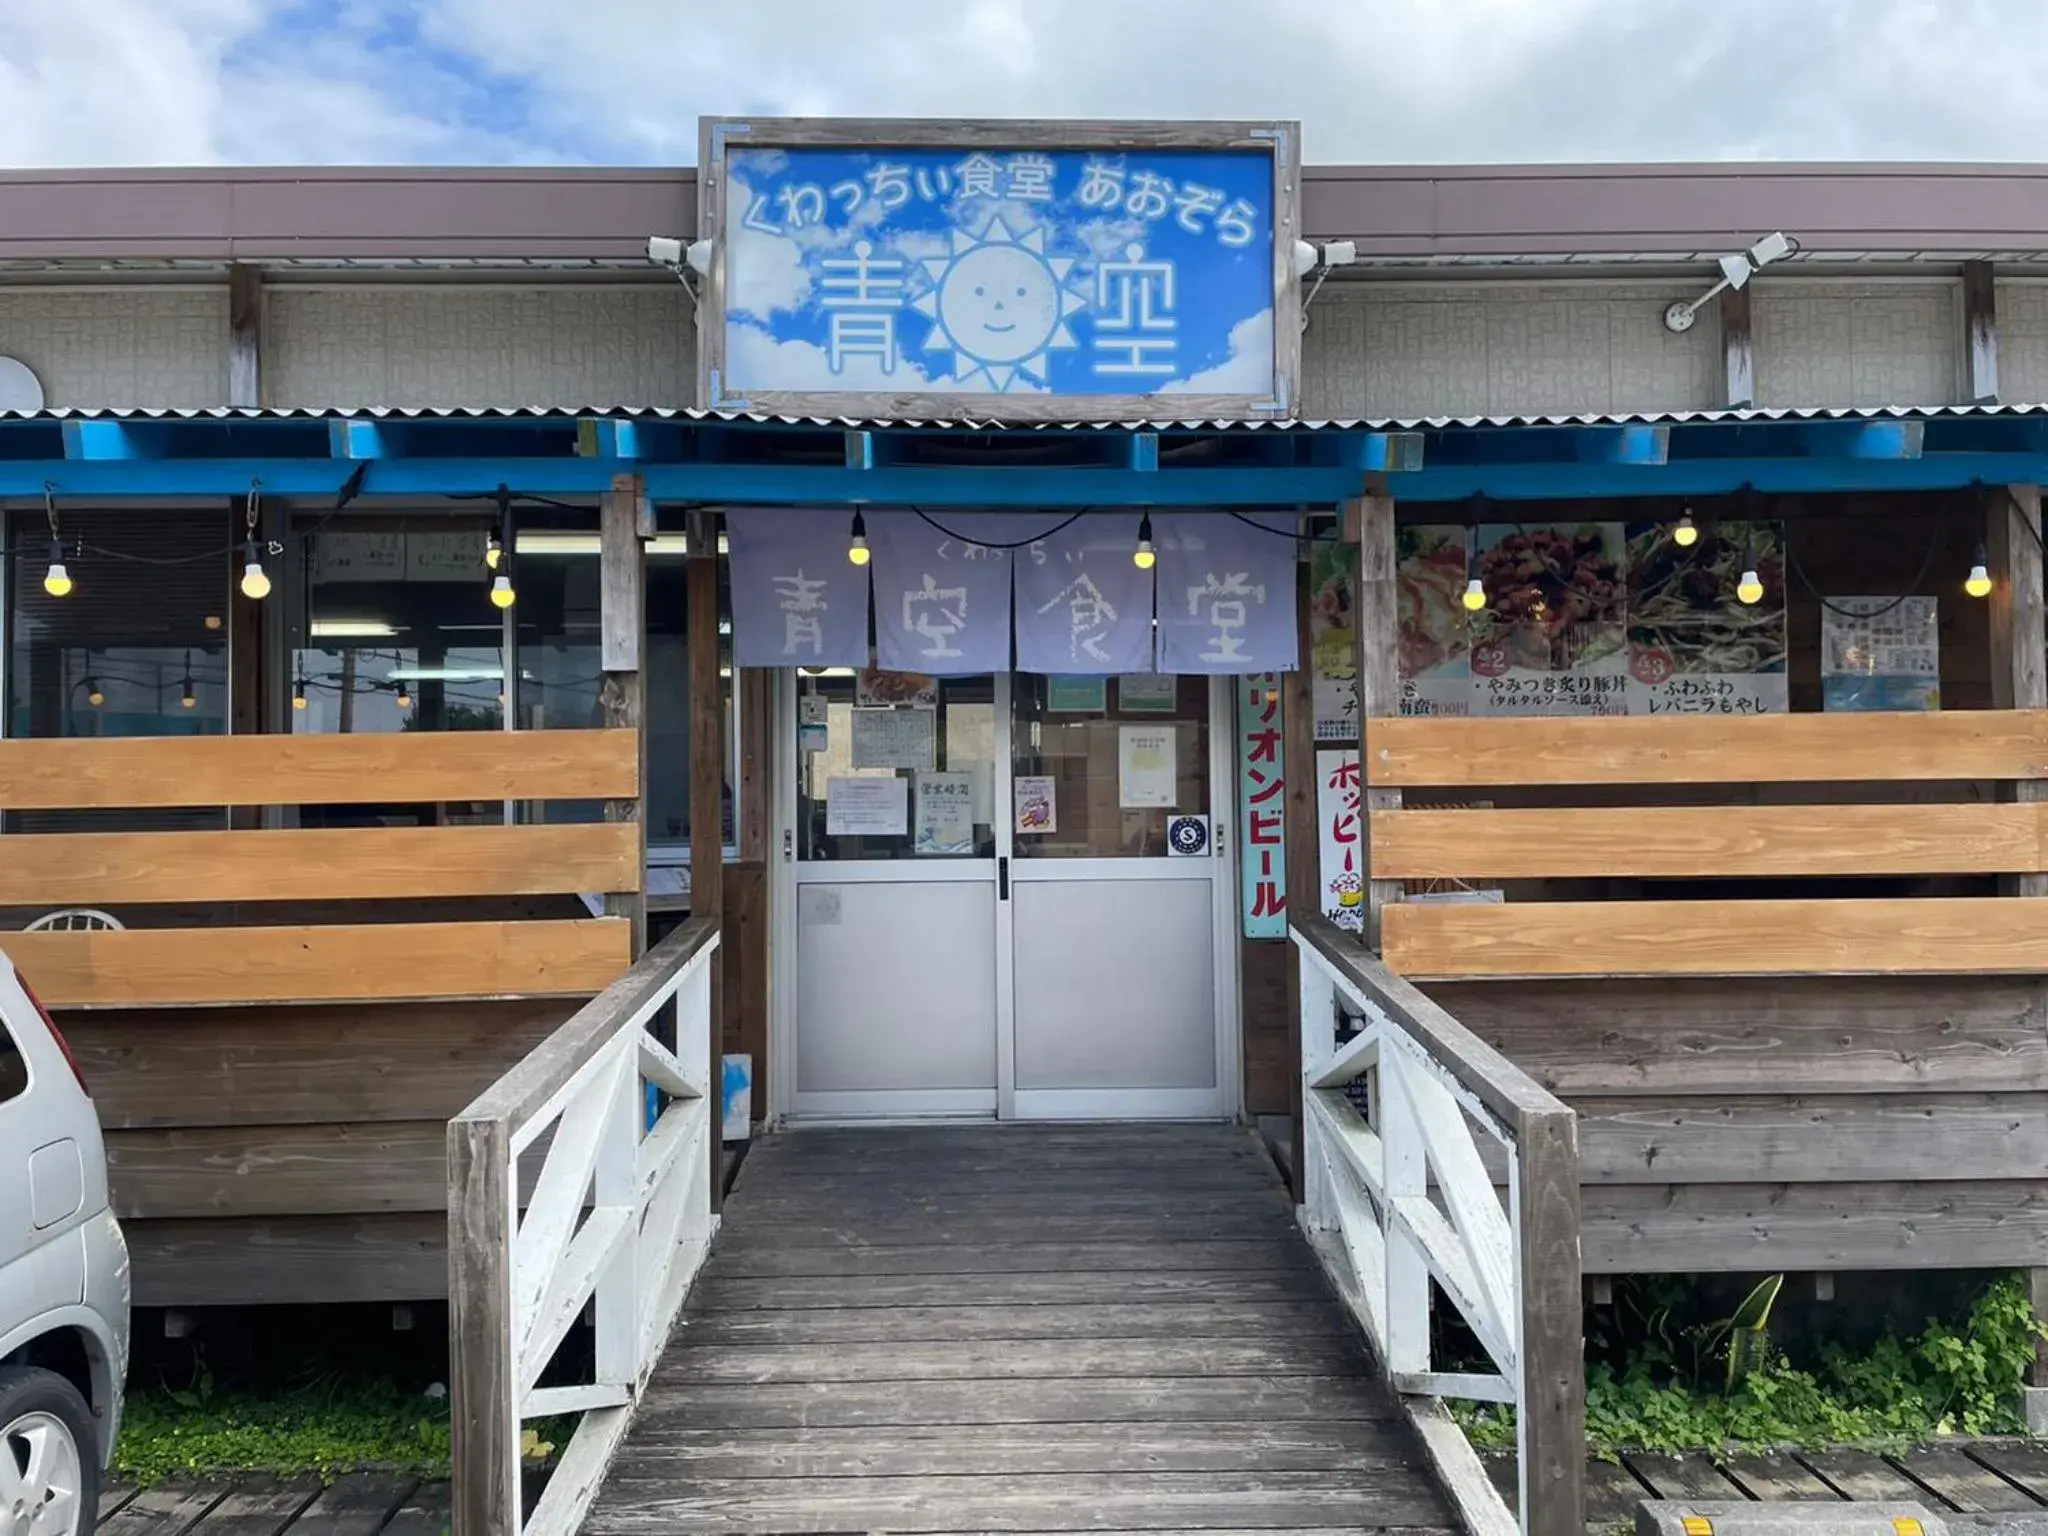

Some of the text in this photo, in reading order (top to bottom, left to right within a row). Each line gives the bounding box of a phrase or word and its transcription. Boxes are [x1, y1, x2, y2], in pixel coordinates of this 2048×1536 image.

[1080, 162, 1258, 246] あおぞら
[1649, 697, 1769, 714] レバニラもやし
[1247, 673, 1287, 917] リオンビール
